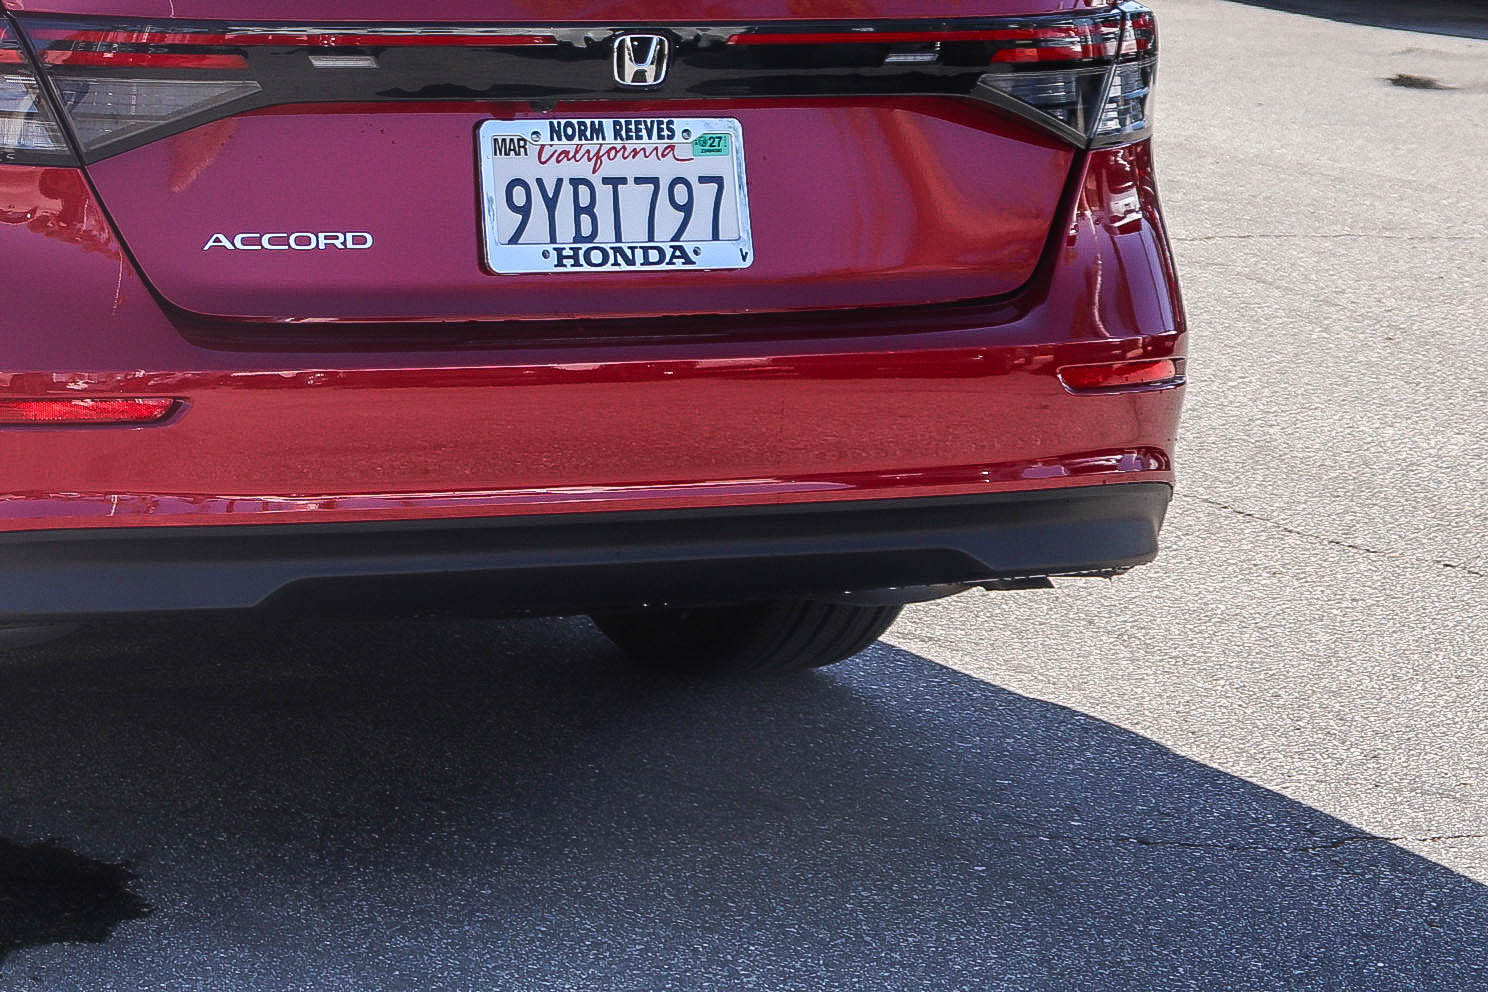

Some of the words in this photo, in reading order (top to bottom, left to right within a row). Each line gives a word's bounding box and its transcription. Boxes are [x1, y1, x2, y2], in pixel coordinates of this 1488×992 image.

[549, 120, 606, 142] NORM
[612, 119, 676, 141] REEVES
[708, 136, 723, 148] 27
[493, 137, 529, 157] MAR
[536, 144, 694, 174] California
[505, 176, 725, 244] 9YBT797
[202, 232, 375, 251] ACCORD
[553, 244, 697, 268] HONDA
